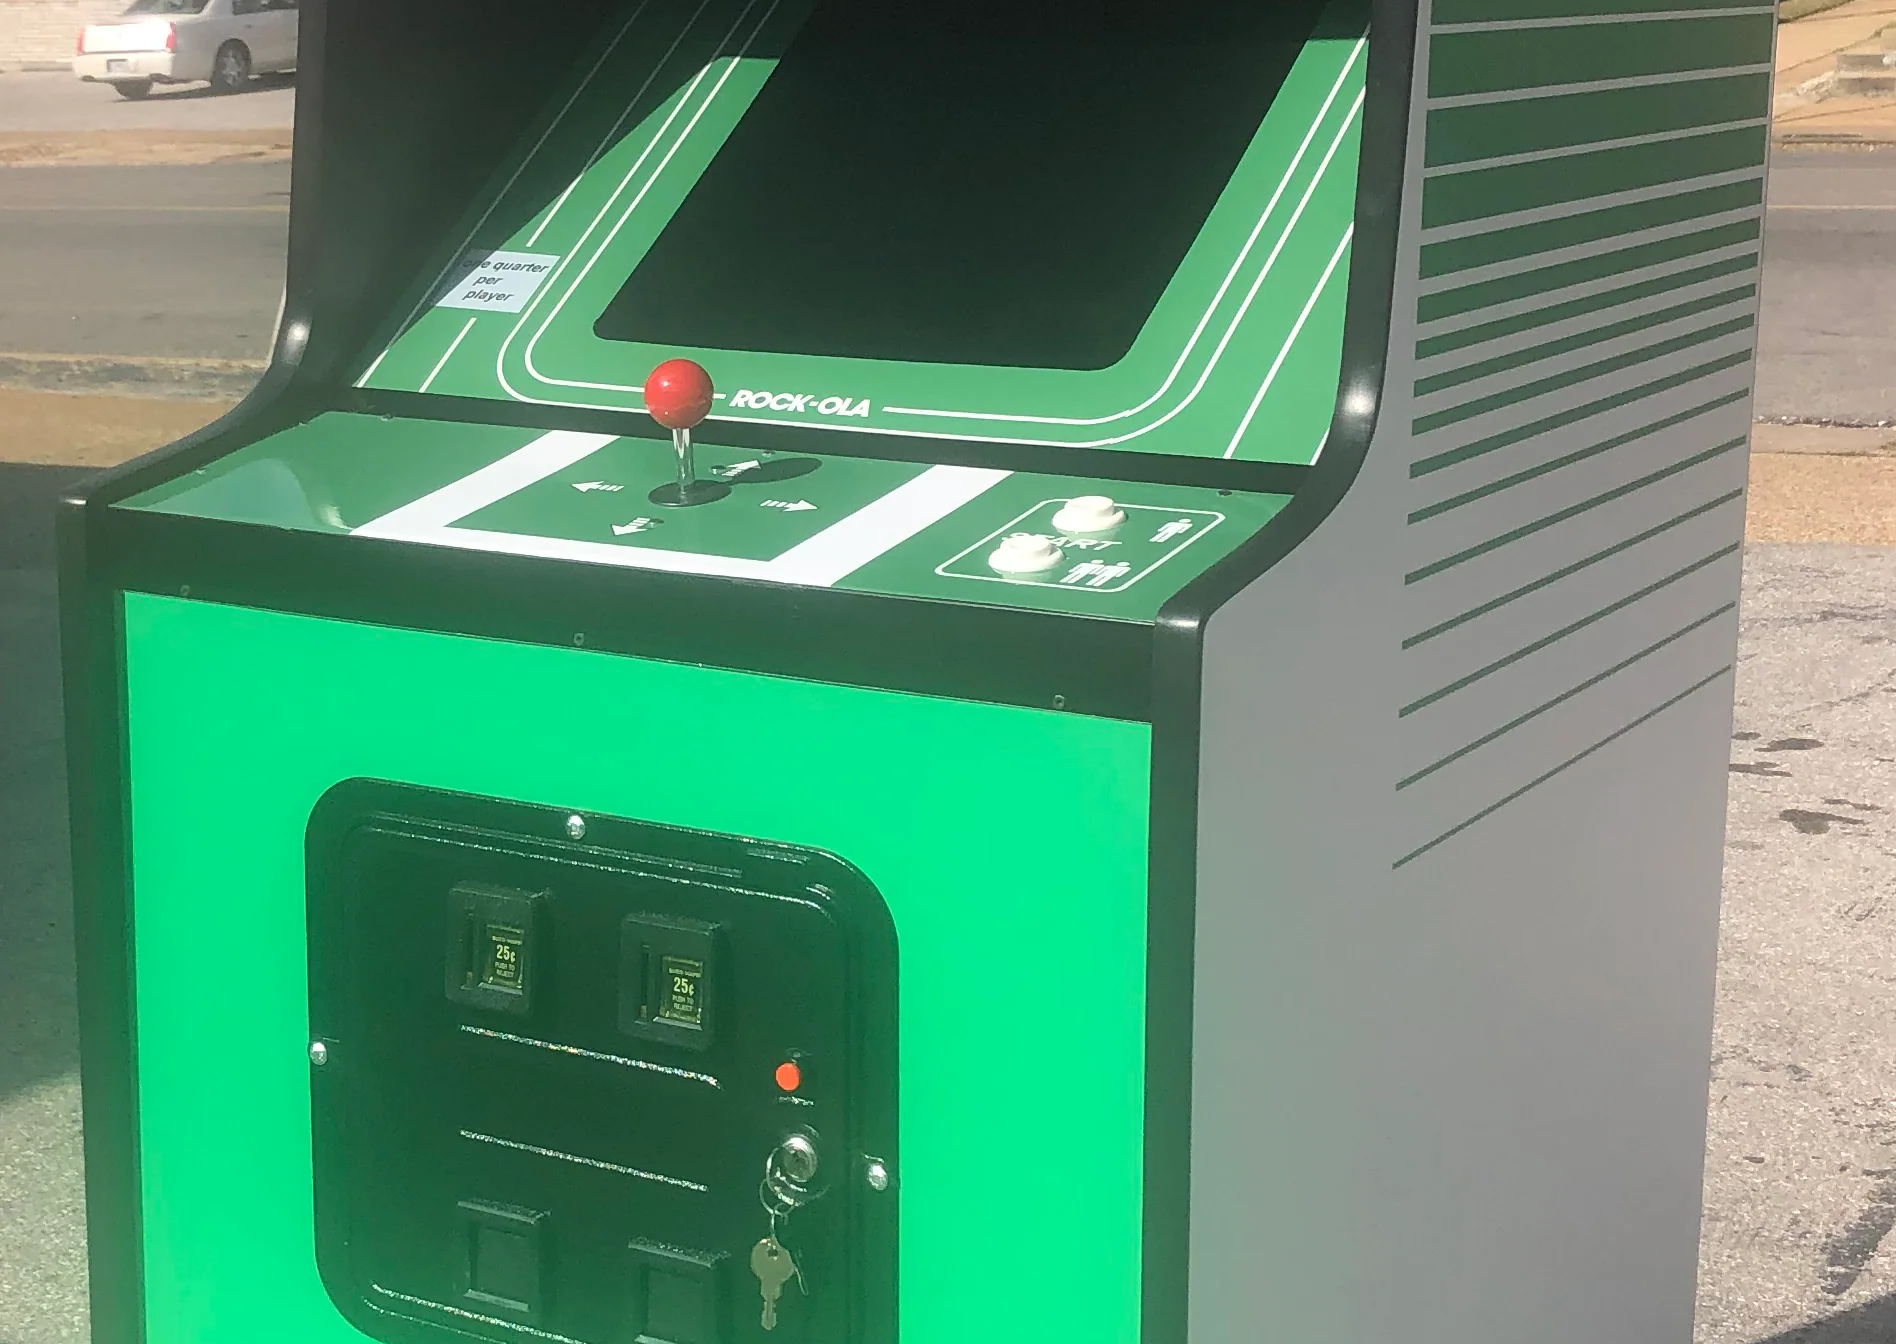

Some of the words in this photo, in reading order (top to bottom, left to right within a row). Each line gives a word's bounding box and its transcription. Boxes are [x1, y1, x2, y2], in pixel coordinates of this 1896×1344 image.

[461, 260, 491, 269] one
[492, 260, 549, 273] quarter
[471, 275, 504, 287] per
[461, 289, 514, 303] player
[728, 389, 872, 418] ROCK-OLA
[496, 943, 516, 964] 25¢
[673, 976, 695, 997] 25¢
